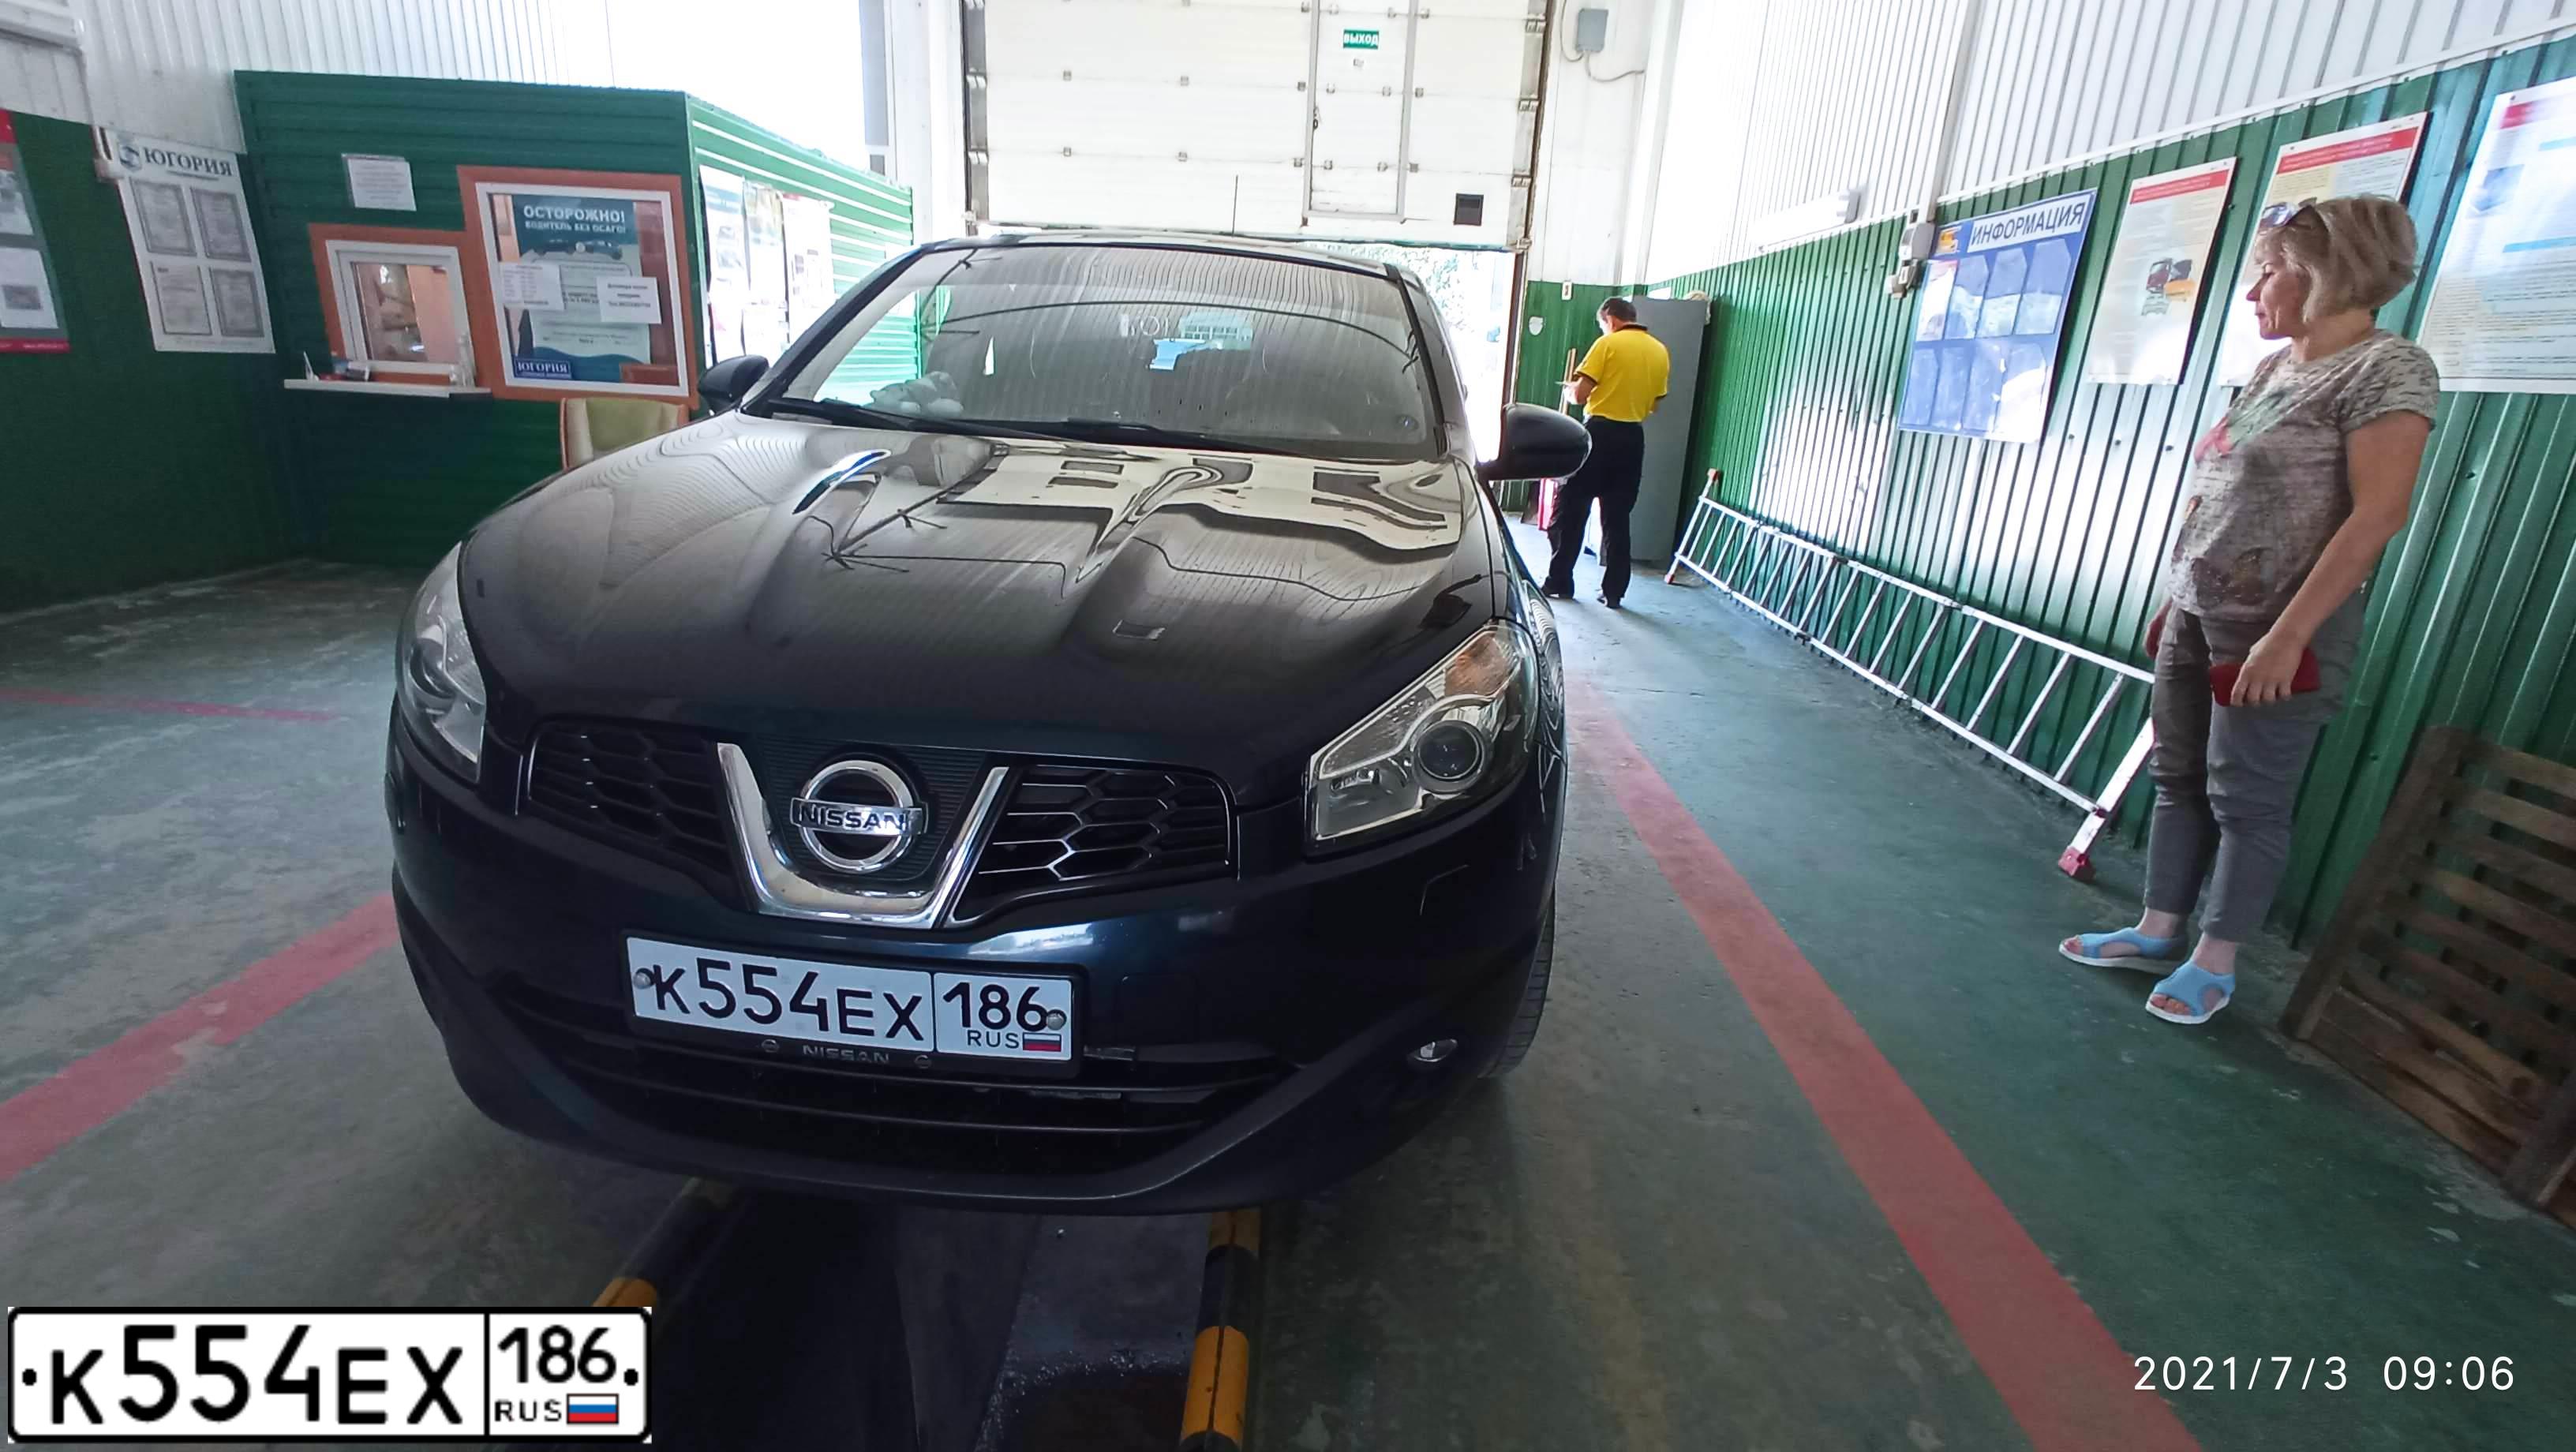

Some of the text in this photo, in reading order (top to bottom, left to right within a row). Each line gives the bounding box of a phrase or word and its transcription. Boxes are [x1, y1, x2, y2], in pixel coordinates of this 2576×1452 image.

[1343, 33, 1379, 46] ВЫХОД
[144, 148, 233, 177] ЮГОРИЯ
[522, 205, 625, 223] ОСТОРОЖНО!
[1971, 202, 2087, 246] ИНФОРМАЦИЯ
[517, 361, 567, 373] ЮГОРИЯ
[798, 800, 908, 833] NISSAN
[942, 982, 1048, 1033] 186
[967, 1030, 1020, 1050] RUS
[802, 1044, 890, 1064] NISSAN
